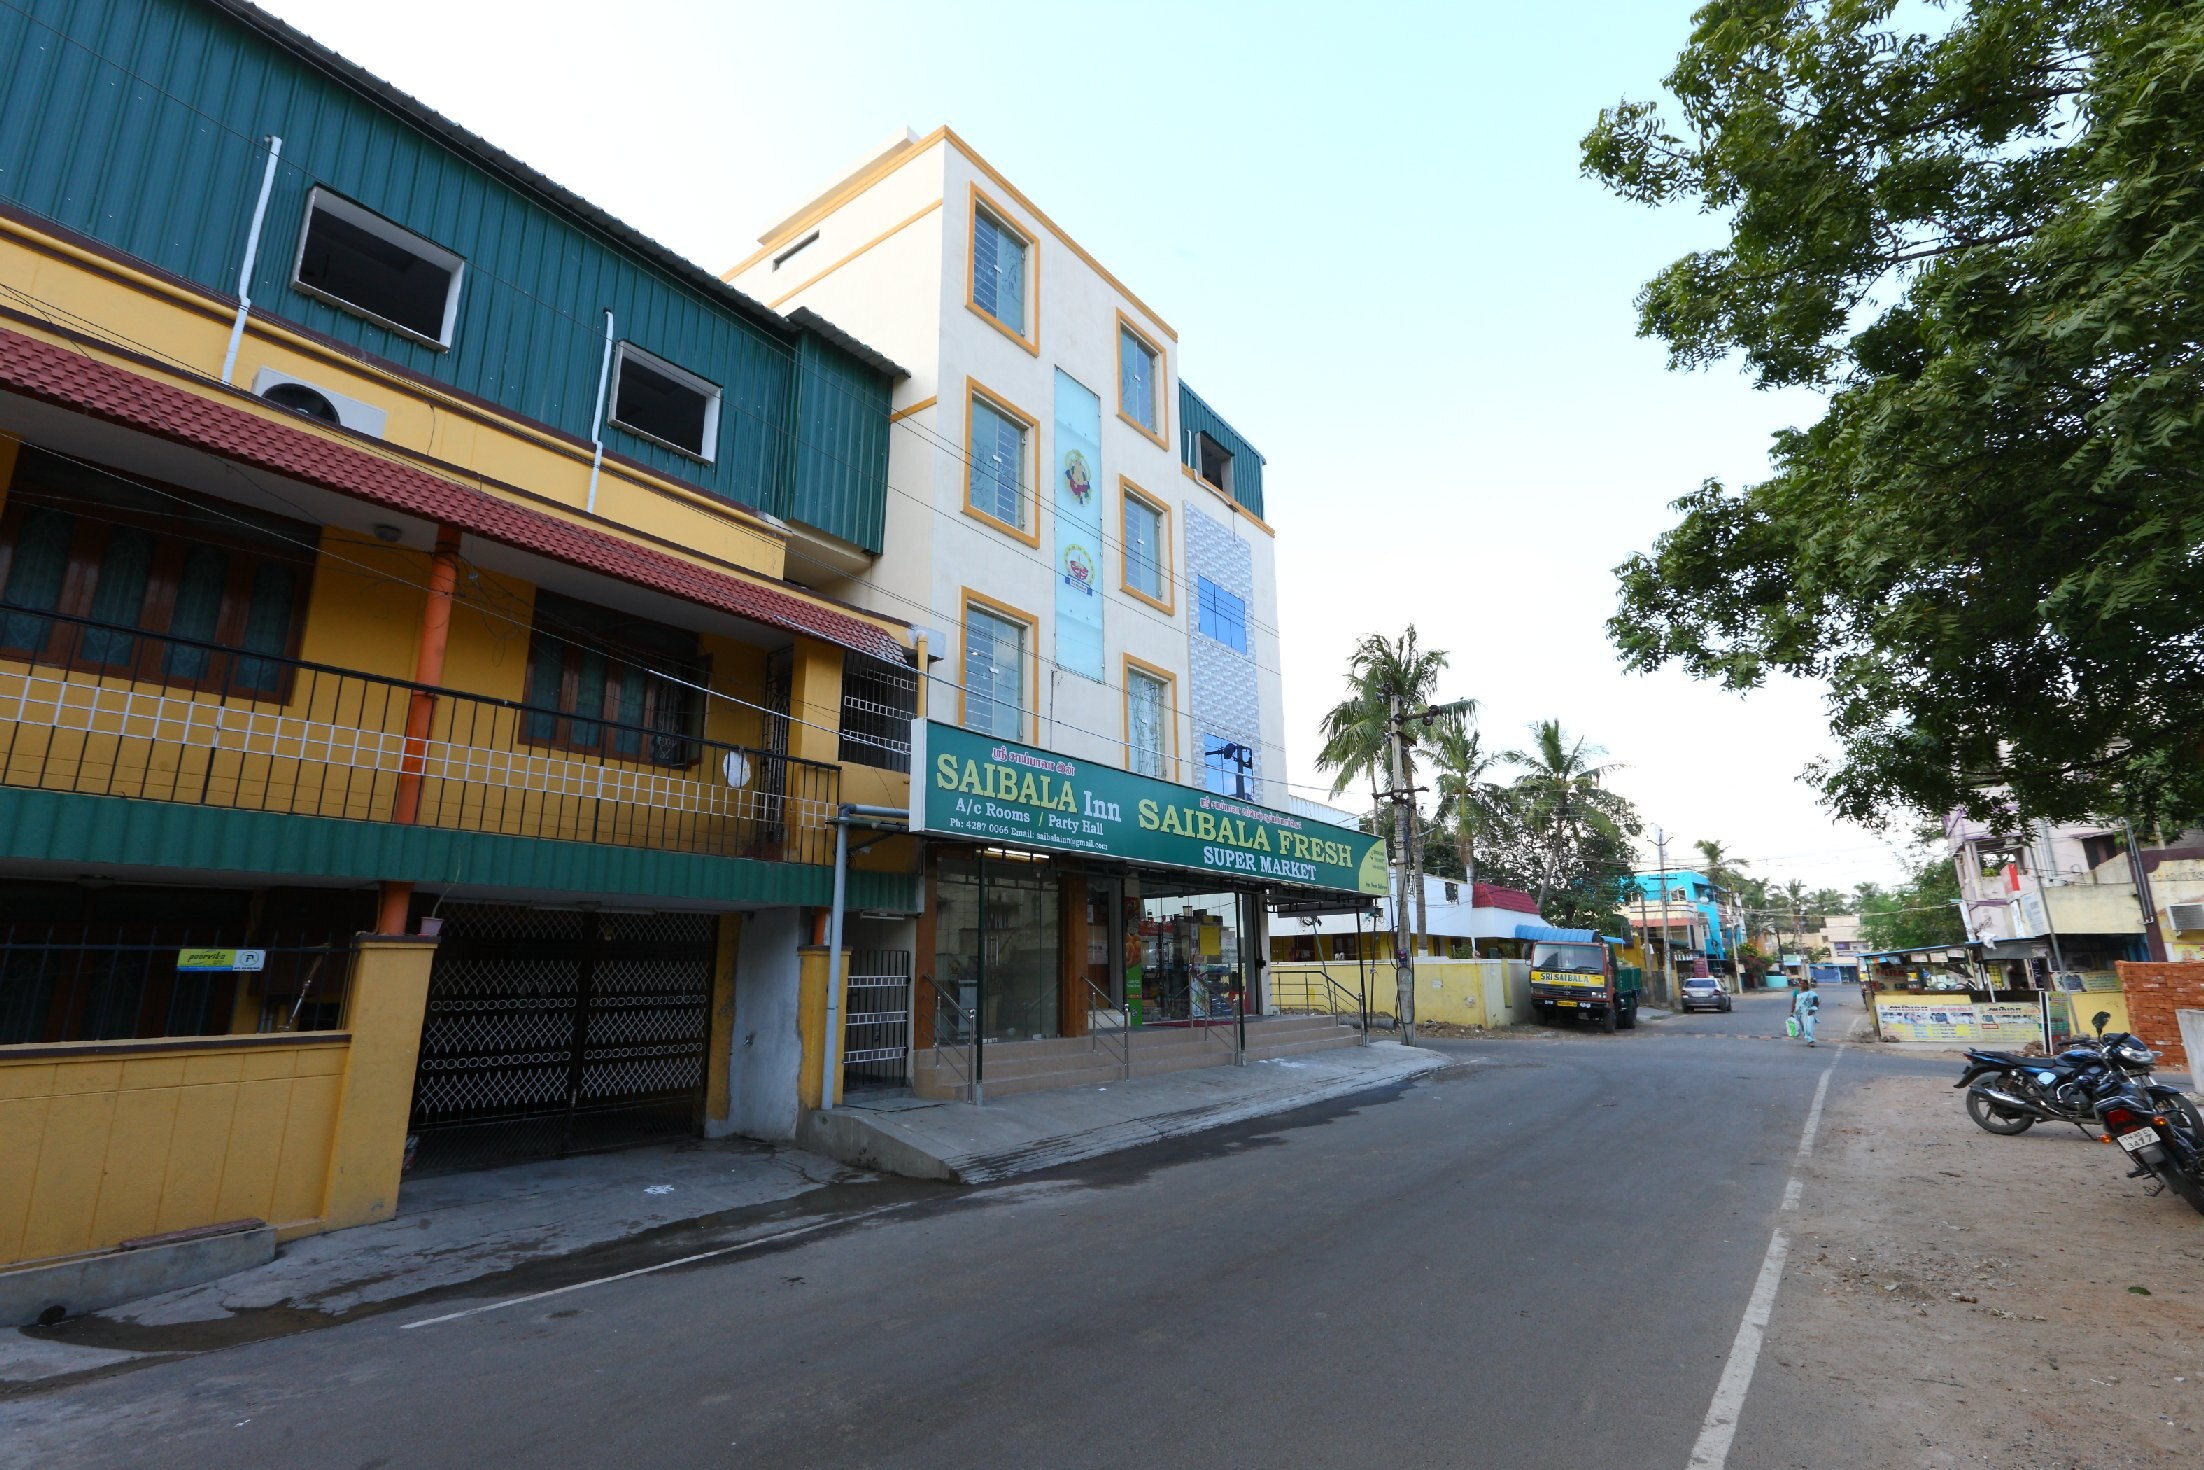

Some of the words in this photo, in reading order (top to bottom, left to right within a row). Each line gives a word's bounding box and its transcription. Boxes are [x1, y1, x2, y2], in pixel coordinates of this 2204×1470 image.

[936, 753, 1078, 813] SAIBALA
[1083, 790, 1121, 822] Inn
[950, 817, 964, 828] Ph:
[966, 820, 987, 832] 4287
[1011, 825, 1035, 839] Email:
[956, 797, 981, 816] A/c
[986, 802, 1030, 823] Rooms
[1048, 814, 1079, 834] Party
[1082, 820, 1103, 836] Hall
[1138, 799, 1271, 852] SAIBALA
[1278, 829, 1353, 868] FRESH
[1203, 846, 1257, 871] SUPER
[1260, 857, 1316, 880] MARKET
[1540, 972, 1553, 981] SRI
